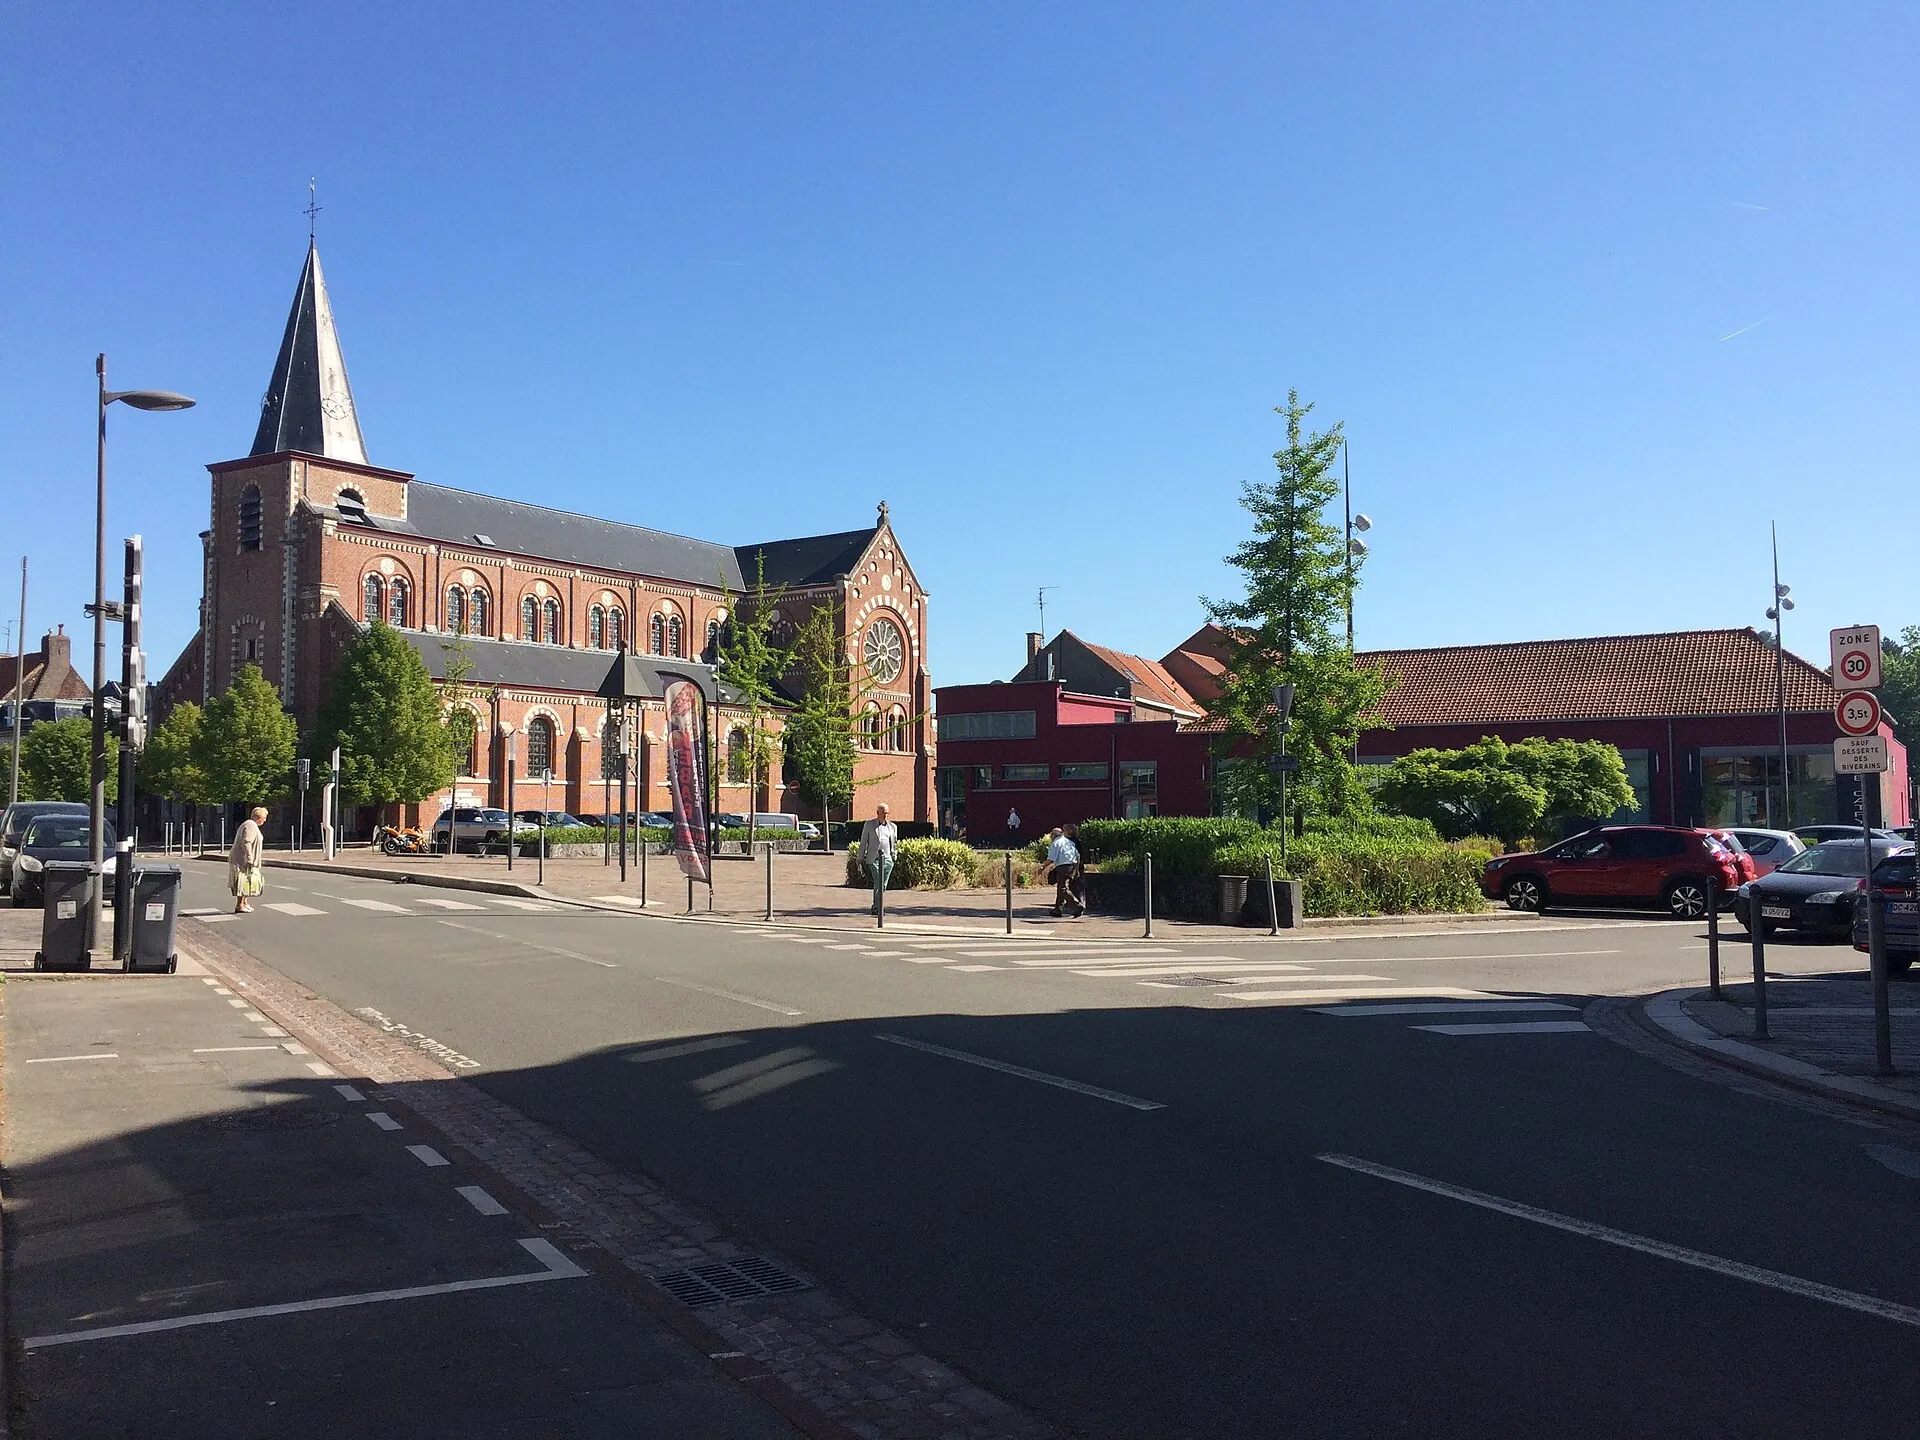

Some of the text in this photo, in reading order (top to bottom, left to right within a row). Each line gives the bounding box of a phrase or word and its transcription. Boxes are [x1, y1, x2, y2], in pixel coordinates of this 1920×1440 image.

[1839, 633, 1870, 645] ZONE
[1847, 659, 1865, 673] 30
[1847, 708, 1868, 720] 3,5t
[1842, 747, 1879, 755] DESSERTE
